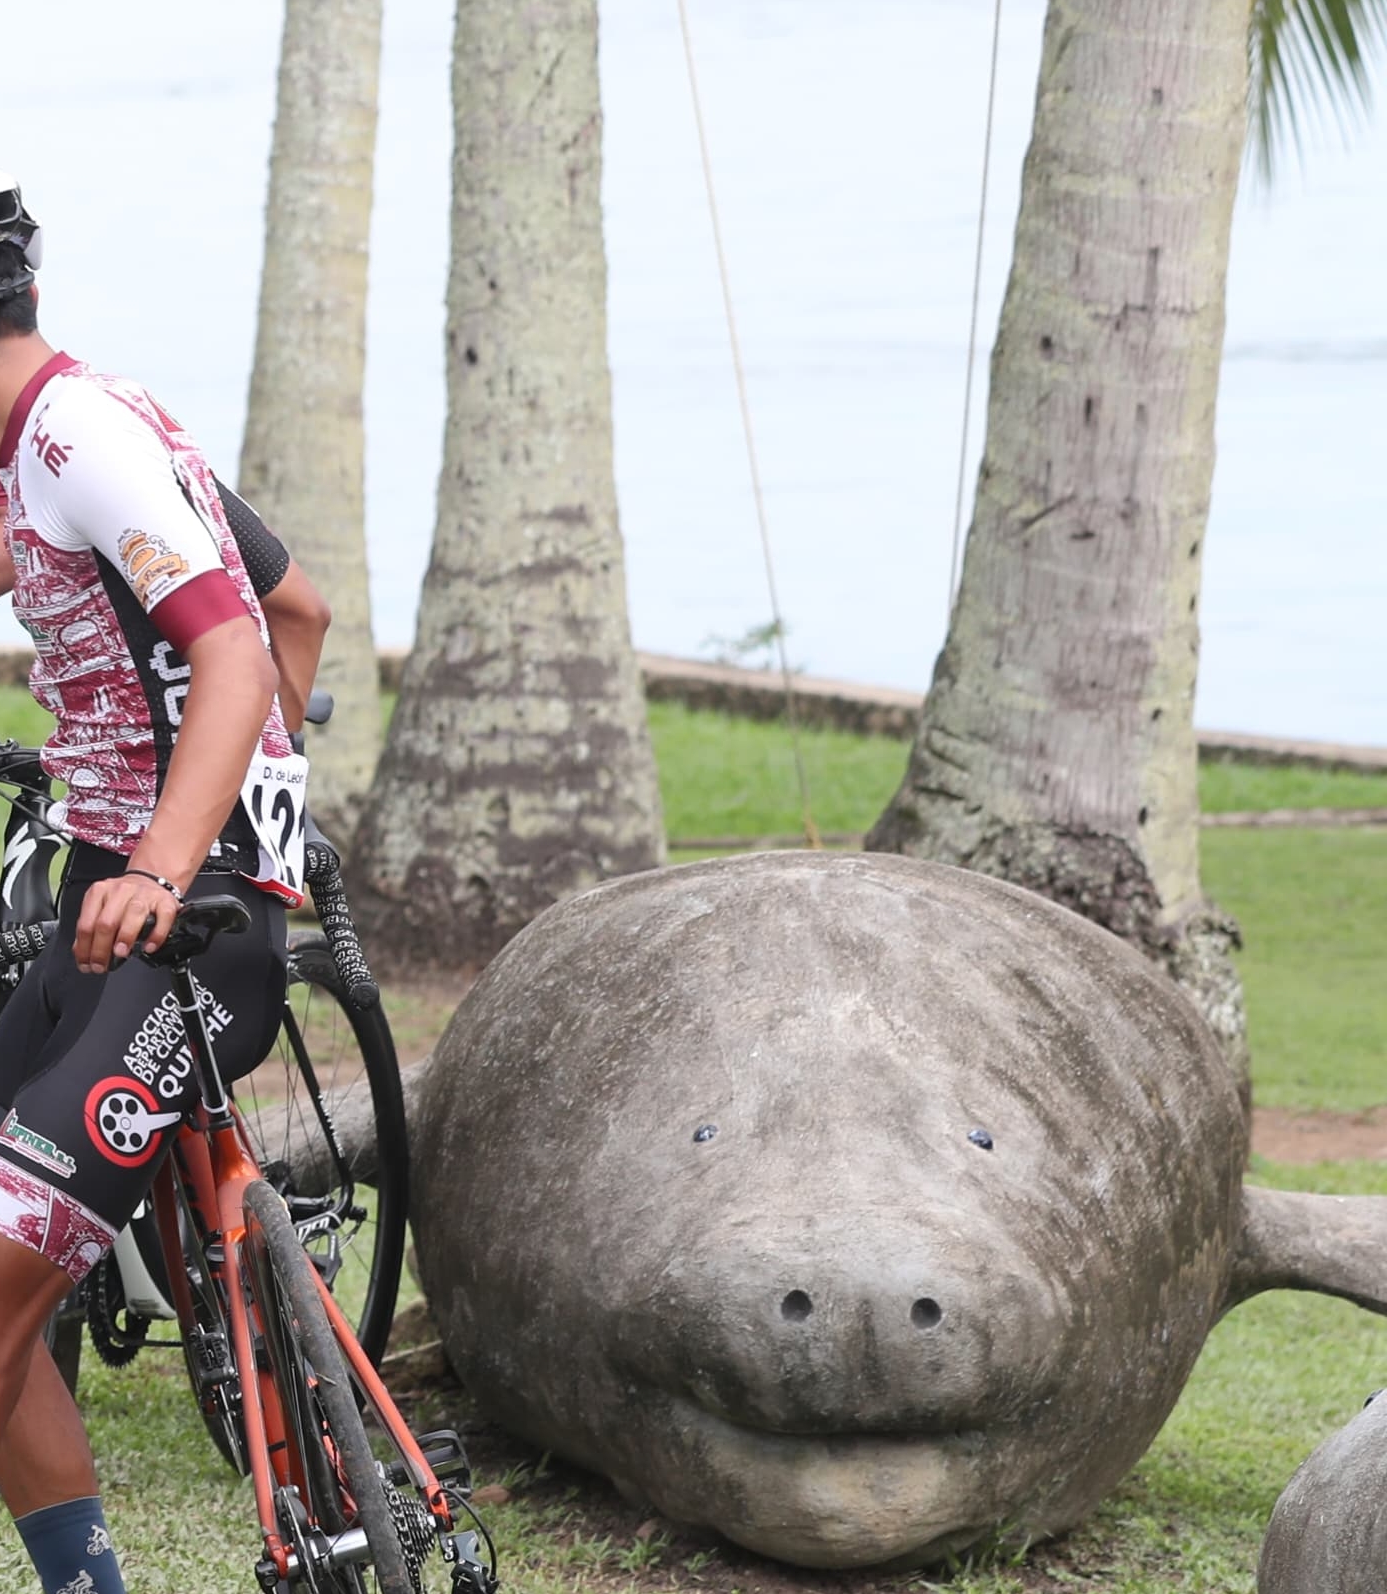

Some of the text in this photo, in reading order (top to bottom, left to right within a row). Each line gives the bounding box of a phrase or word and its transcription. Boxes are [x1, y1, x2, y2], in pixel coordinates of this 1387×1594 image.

[263, 766, 274, 781] D.
[276, 771, 286, 782] de
[140, 1061, 161, 1085] DE
